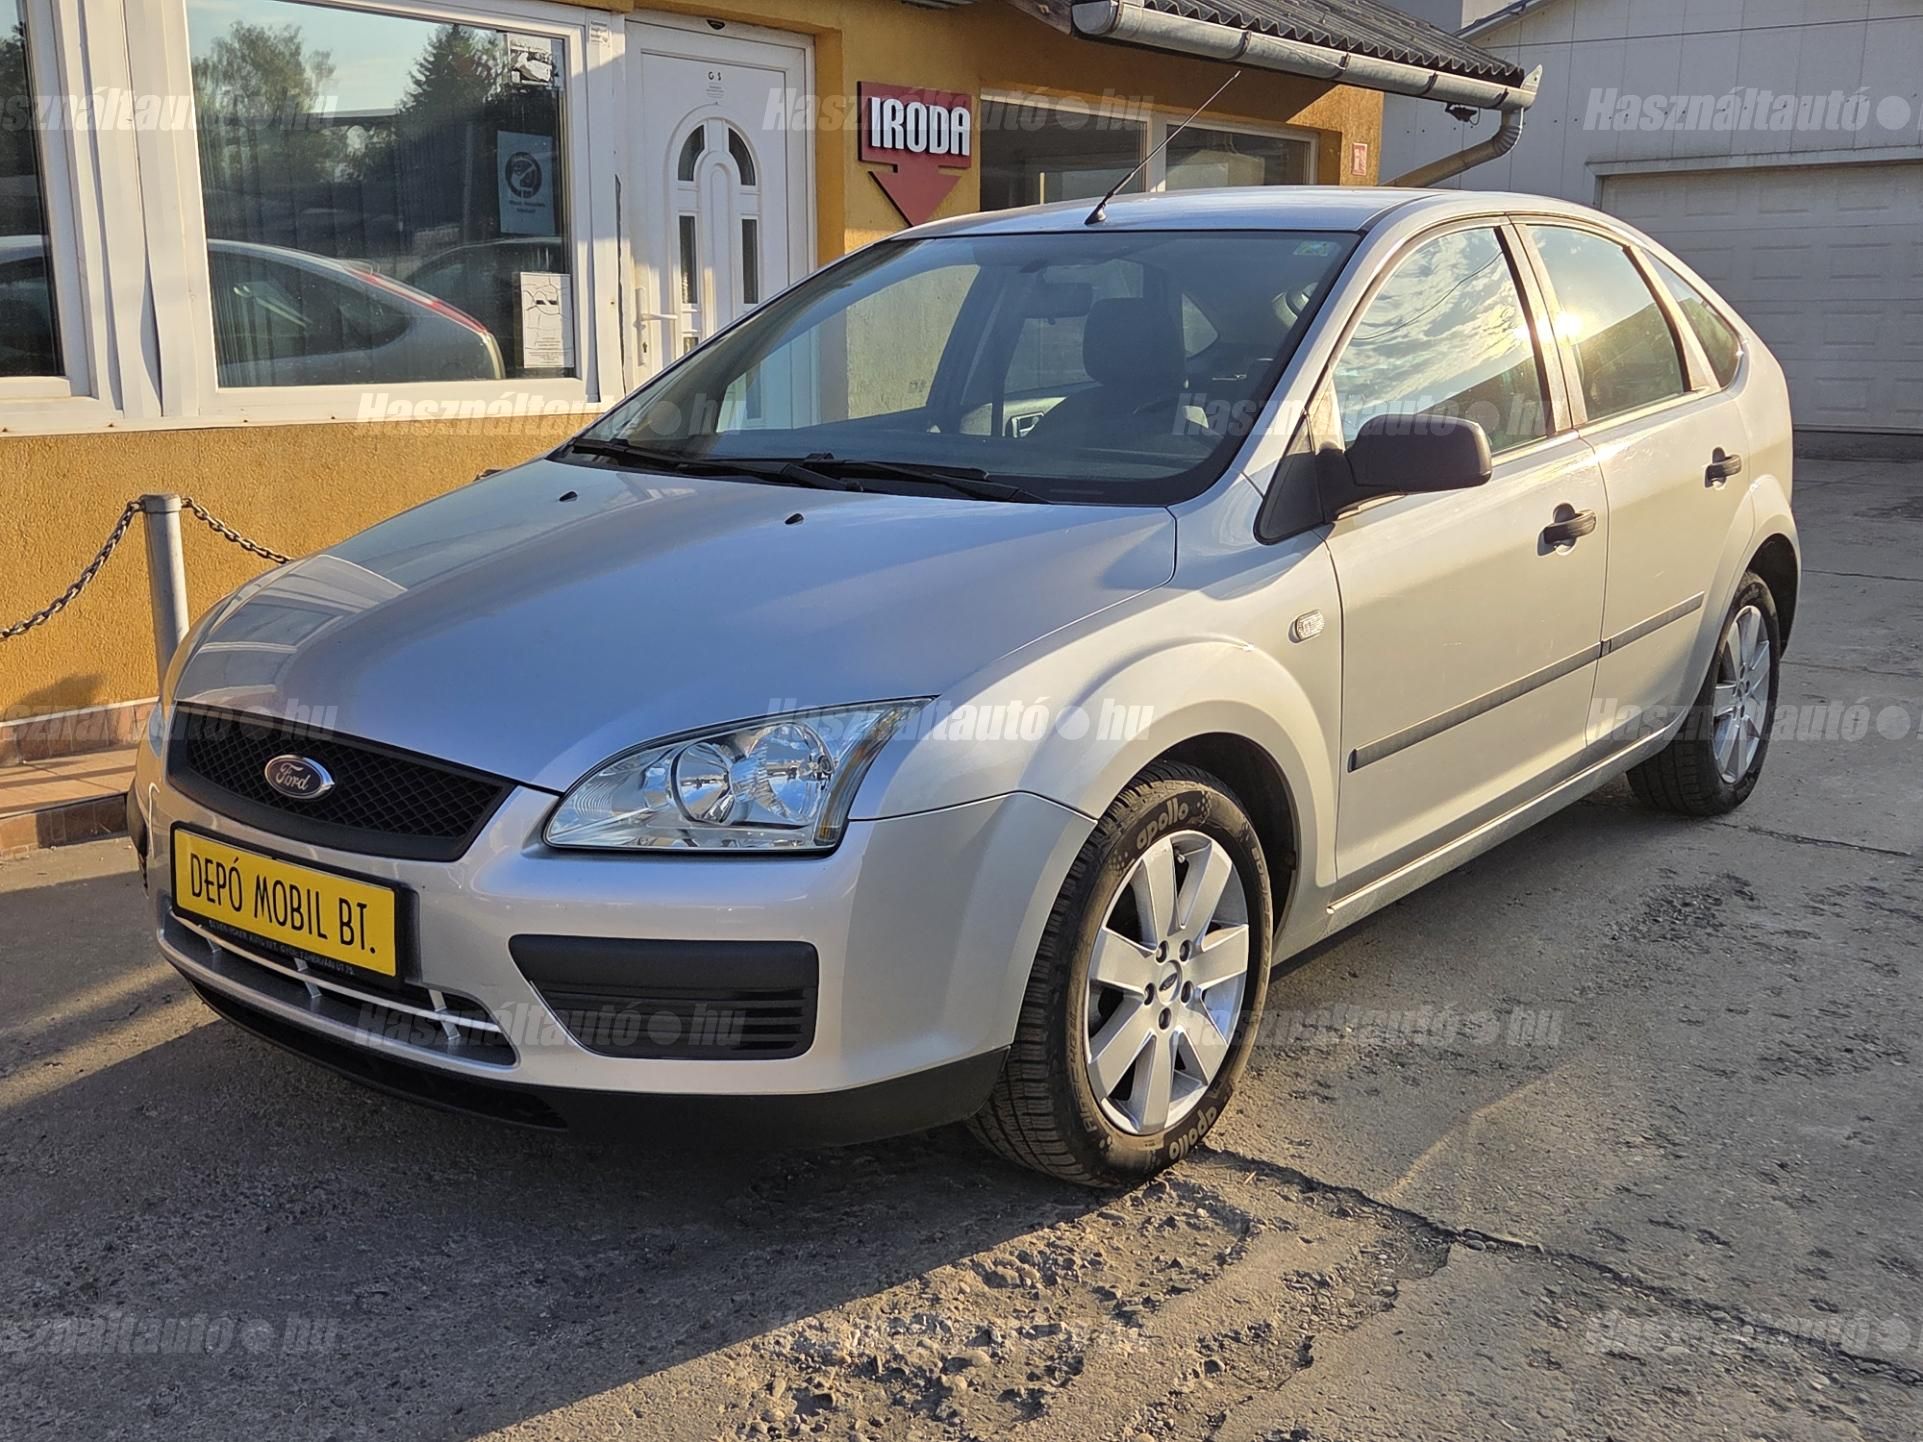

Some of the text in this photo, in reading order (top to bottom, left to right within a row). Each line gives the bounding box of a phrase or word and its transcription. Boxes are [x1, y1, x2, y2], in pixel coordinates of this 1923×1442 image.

[868, 96, 971, 157] IRODA
[275, 762, 311, 790] Ford
[1136, 797, 1190, 849] apollo
[190, 853, 243, 912] DEPÓ
[254, 874, 328, 940] MOBIL
[338, 897, 376, 955] BT.
[1167, 1105, 1218, 1160] apollo
